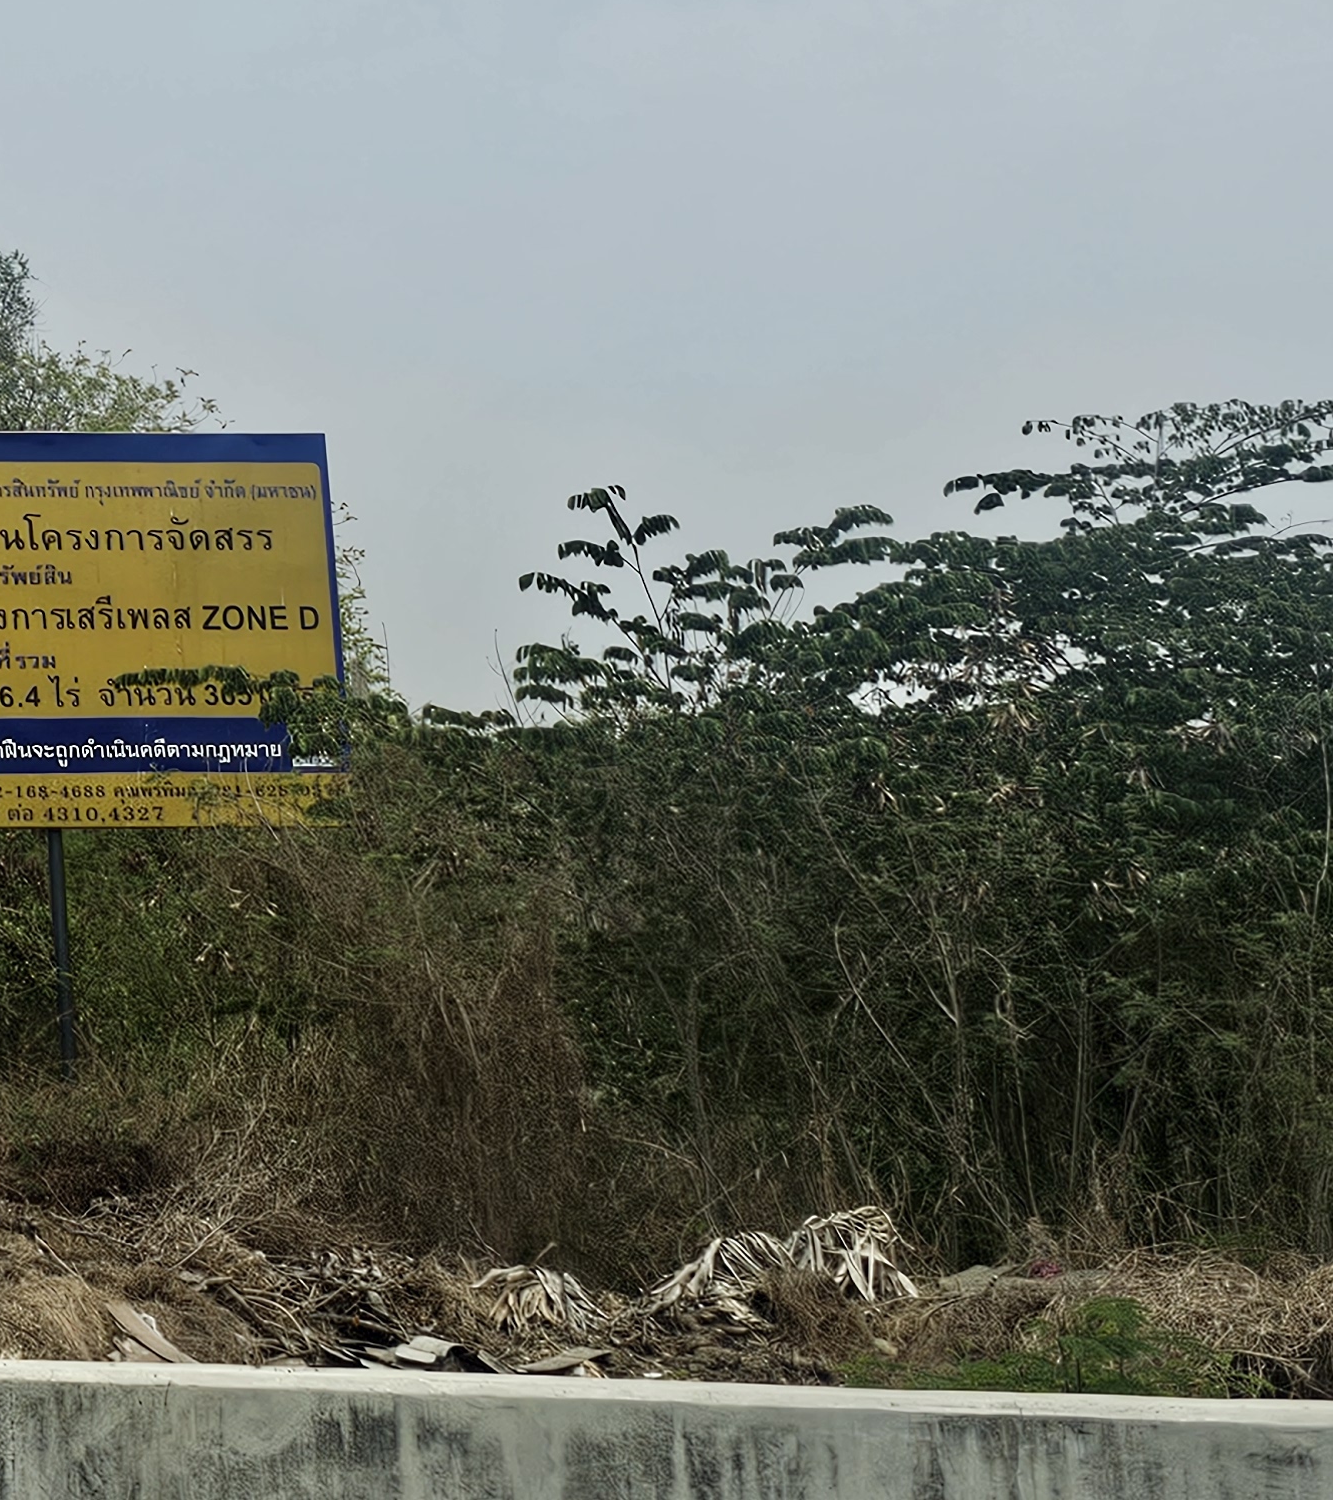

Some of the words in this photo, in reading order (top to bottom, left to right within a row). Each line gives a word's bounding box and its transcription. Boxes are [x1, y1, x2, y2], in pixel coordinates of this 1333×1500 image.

[202, 605, 289, 630] ZONE
[299, 606, 320, 630] D
[47, 675, 80, 707] ไร่
[8, 803, 33, 820] ต่อ
